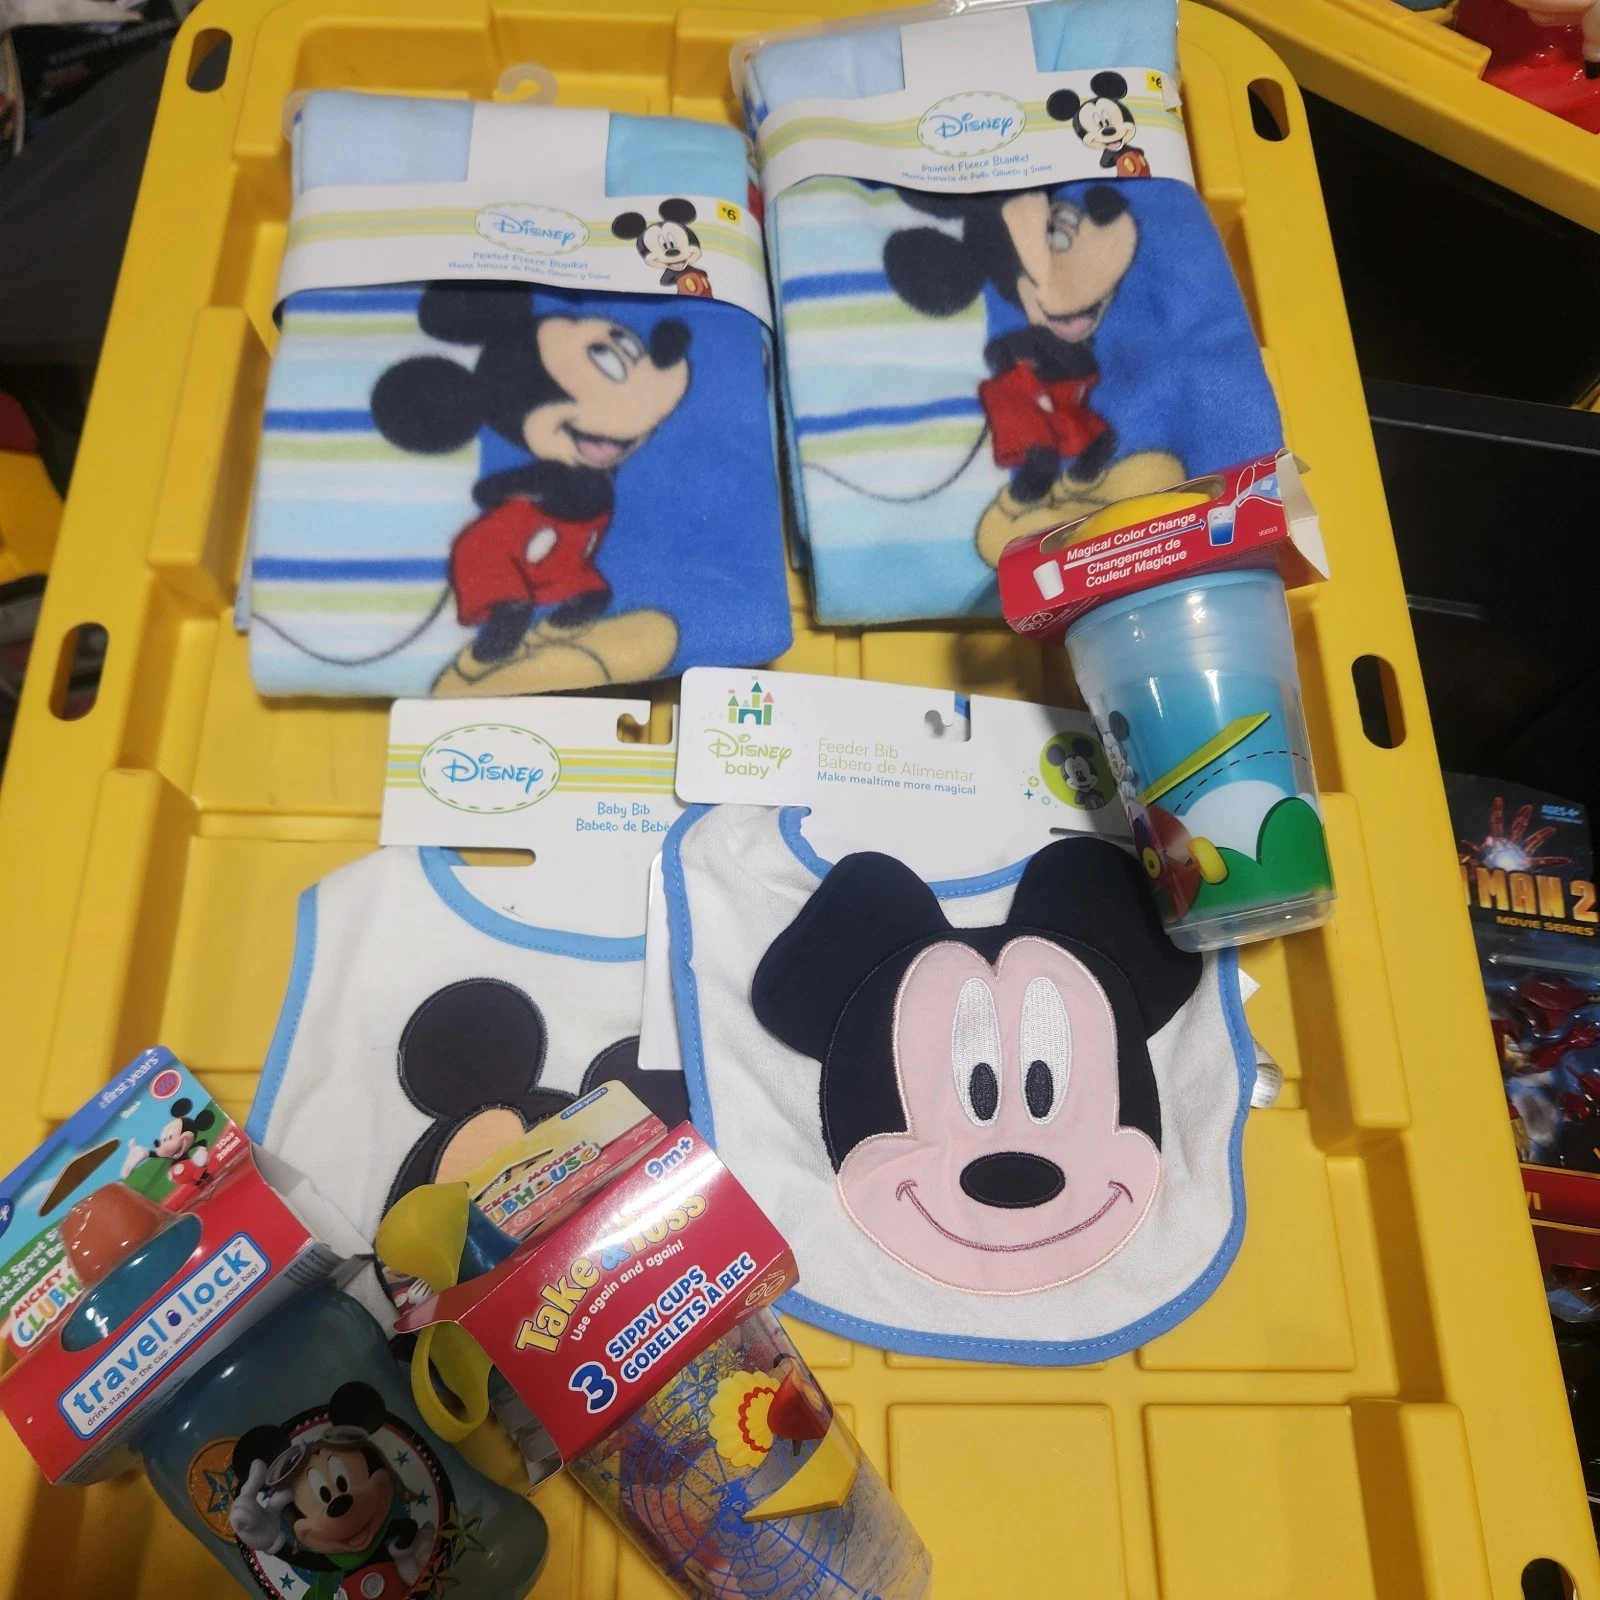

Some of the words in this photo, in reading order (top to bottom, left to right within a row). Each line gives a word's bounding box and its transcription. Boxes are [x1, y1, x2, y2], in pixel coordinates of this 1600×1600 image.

[929, 112, 1013, 138] Disney
[958, 160, 989, 172] Fleece
[993, 154, 1029, 166] Blanket
[488, 211, 576, 247] Disney
[549, 259, 589, 270] Blanket
[1067, 538, 1111, 562] Magical
[1114, 528, 1147, 545] Color
[1149, 513, 1196, 534] Change
[1087, 543, 1162, 575] Changement
[1165, 539, 1181, 550] de
[1086, 566, 1132, 588] Couleur
[1135, 551, 1187, 573] Magique
[704, 728, 792, 769] Disney
[818, 737, 869, 756] Feeder
[874, 743, 899, 759] Bib
[818, 753, 872, 772] Babero
[877, 760, 896, 774] de
[900, 762, 975, 782] Alimentar
[436, 748, 543, 793] Disney
[724, 760, 770, 780] baby
[817, 771, 847, 782] Make
[850, 775, 900, 788] mealtime
[903, 780, 931, 791] more
[934, 784, 976, 795] magical
[597, 801, 627, 818] Baby
[632, 802, 651, 816] Bib
[623, 820, 637, 832] de
[642, 819, 670, 833] Bebé
[1476, 867, 1566, 919] MAN
[1569, 879, 1599, 923] 2
[1496, 915, 1540, 929] MOVIE
[1543, 921, 1596, 937] SERIES
[125, 1057, 158, 1087] years
[482, 1183, 523, 1213] CKEY
[528, 1144, 582, 1183] MOUSE
[647, 1139, 691, 1180] 9m+
[486, 1146, 597, 1225] UBHOUSE
[10, 1240, 47, 1276] Spout
[0, 1266, 38, 1307] obelet
[14, 1268, 62, 1319] MICKEY
[515, 1256, 600, 1353] Take
[600, 1243, 631, 1271] &
[570, 1314, 591, 1342] Use
[589, 1281, 620, 1314] again
[619, 1261, 645, 1284] and
[646, 1239, 685, 1268] again!
[17, 1274, 82, 1342] CLUBH
[608, 1307, 659, 1359] SIPPY
[659, 1267, 705, 1312] CUPS
[623, 1300, 707, 1380] GOBELETS
[703, 1284, 722, 1305] À
[718, 1254, 754, 1291] BEC
[73, 1318, 168, 1414] travel
[177, 1248, 252, 1315] lock
[87, 1404, 109, 1427] drink
[109, 1385, 130, 1407] stays
[129, 1376, 139, 1387] in
[139, 1363, 154, 1378] the
[153, 1348, 169, 1365] cup
[174, 1322, 198, 1345] won't
[196, 1307, 214, 1327] leak
[214, 1299, 223, 1310] in
[223, 1283, 242, 1303] your
[241, 1263, 260, 1283] bag!
[571, 1362, 617, 1412] 3
